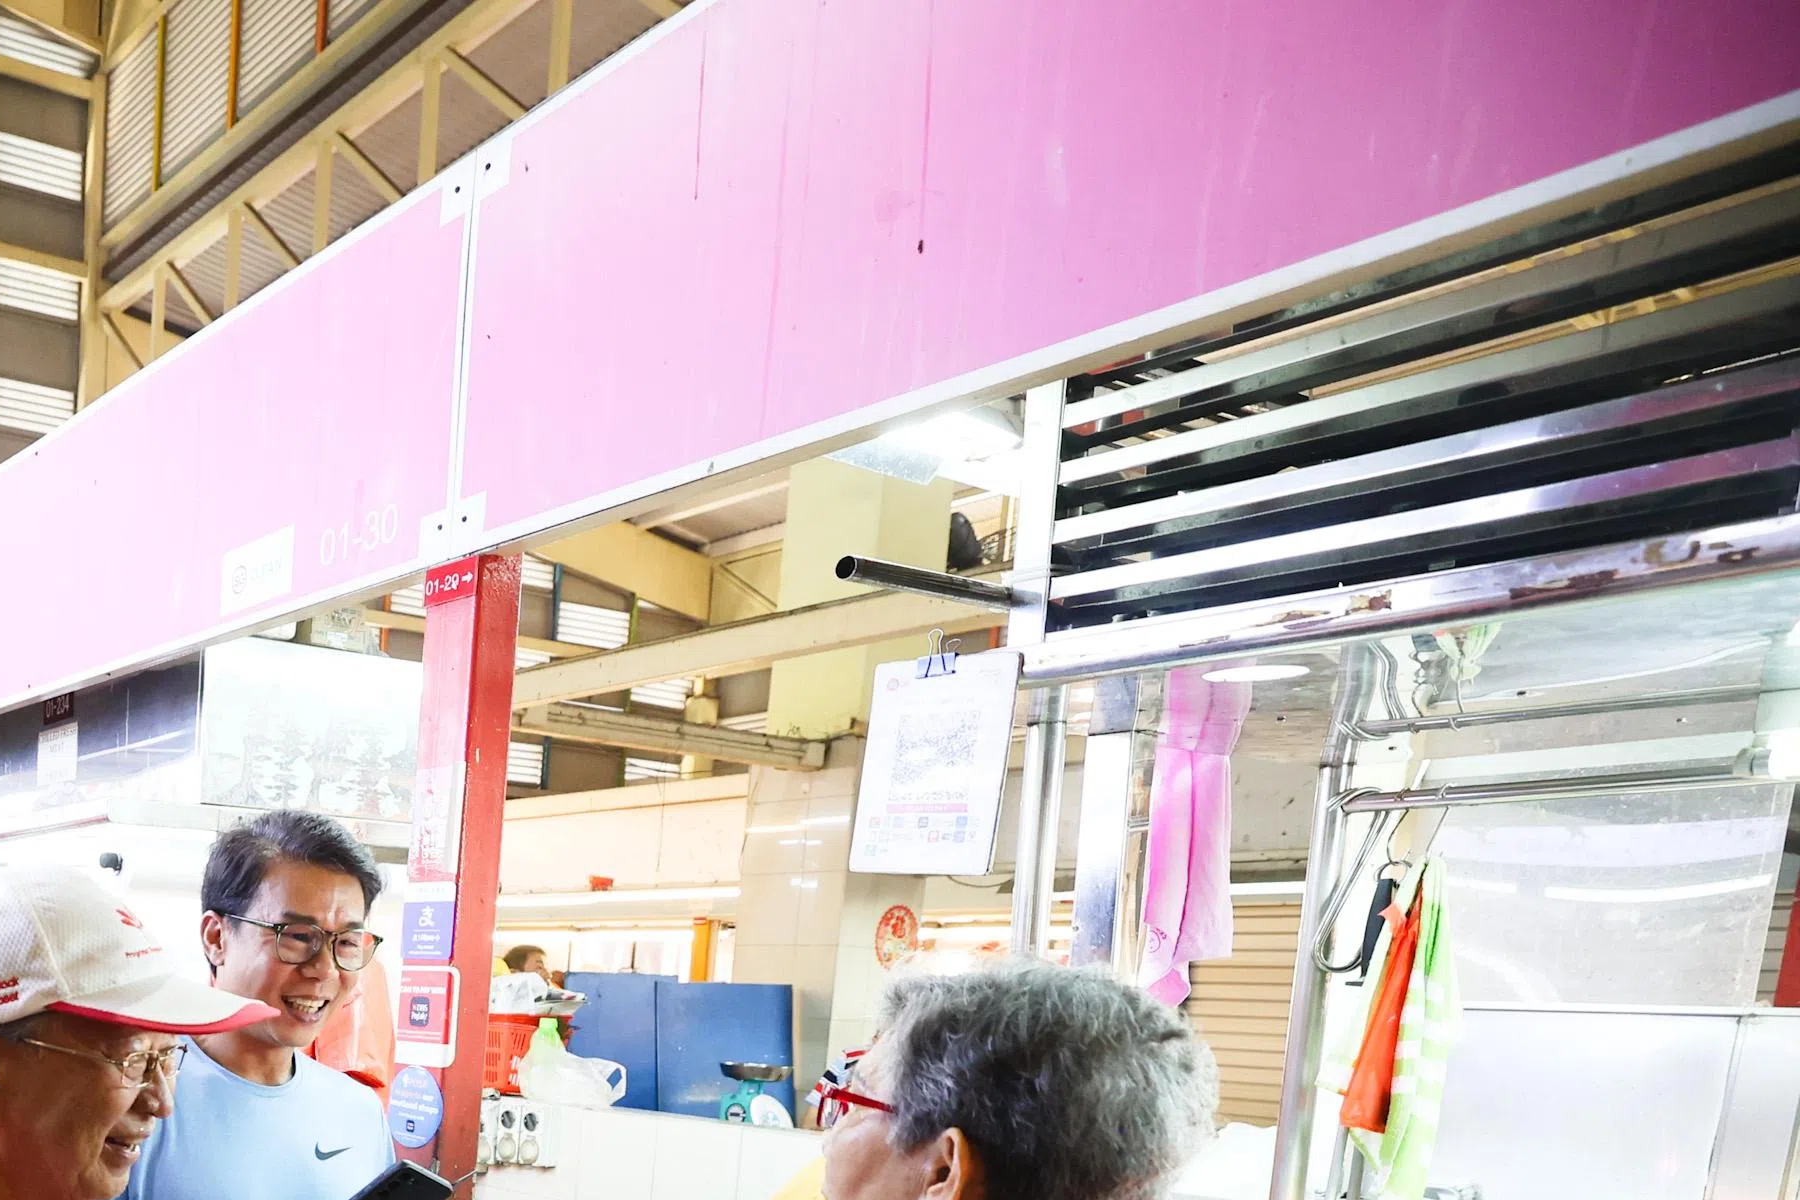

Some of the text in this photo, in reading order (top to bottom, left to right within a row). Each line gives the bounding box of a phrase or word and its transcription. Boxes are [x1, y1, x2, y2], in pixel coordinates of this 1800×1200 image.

[320, 503, 399, 566] 01-30
[426, 573, 459, 596] 01-29
[46, 694, 70, 718] 01-234
